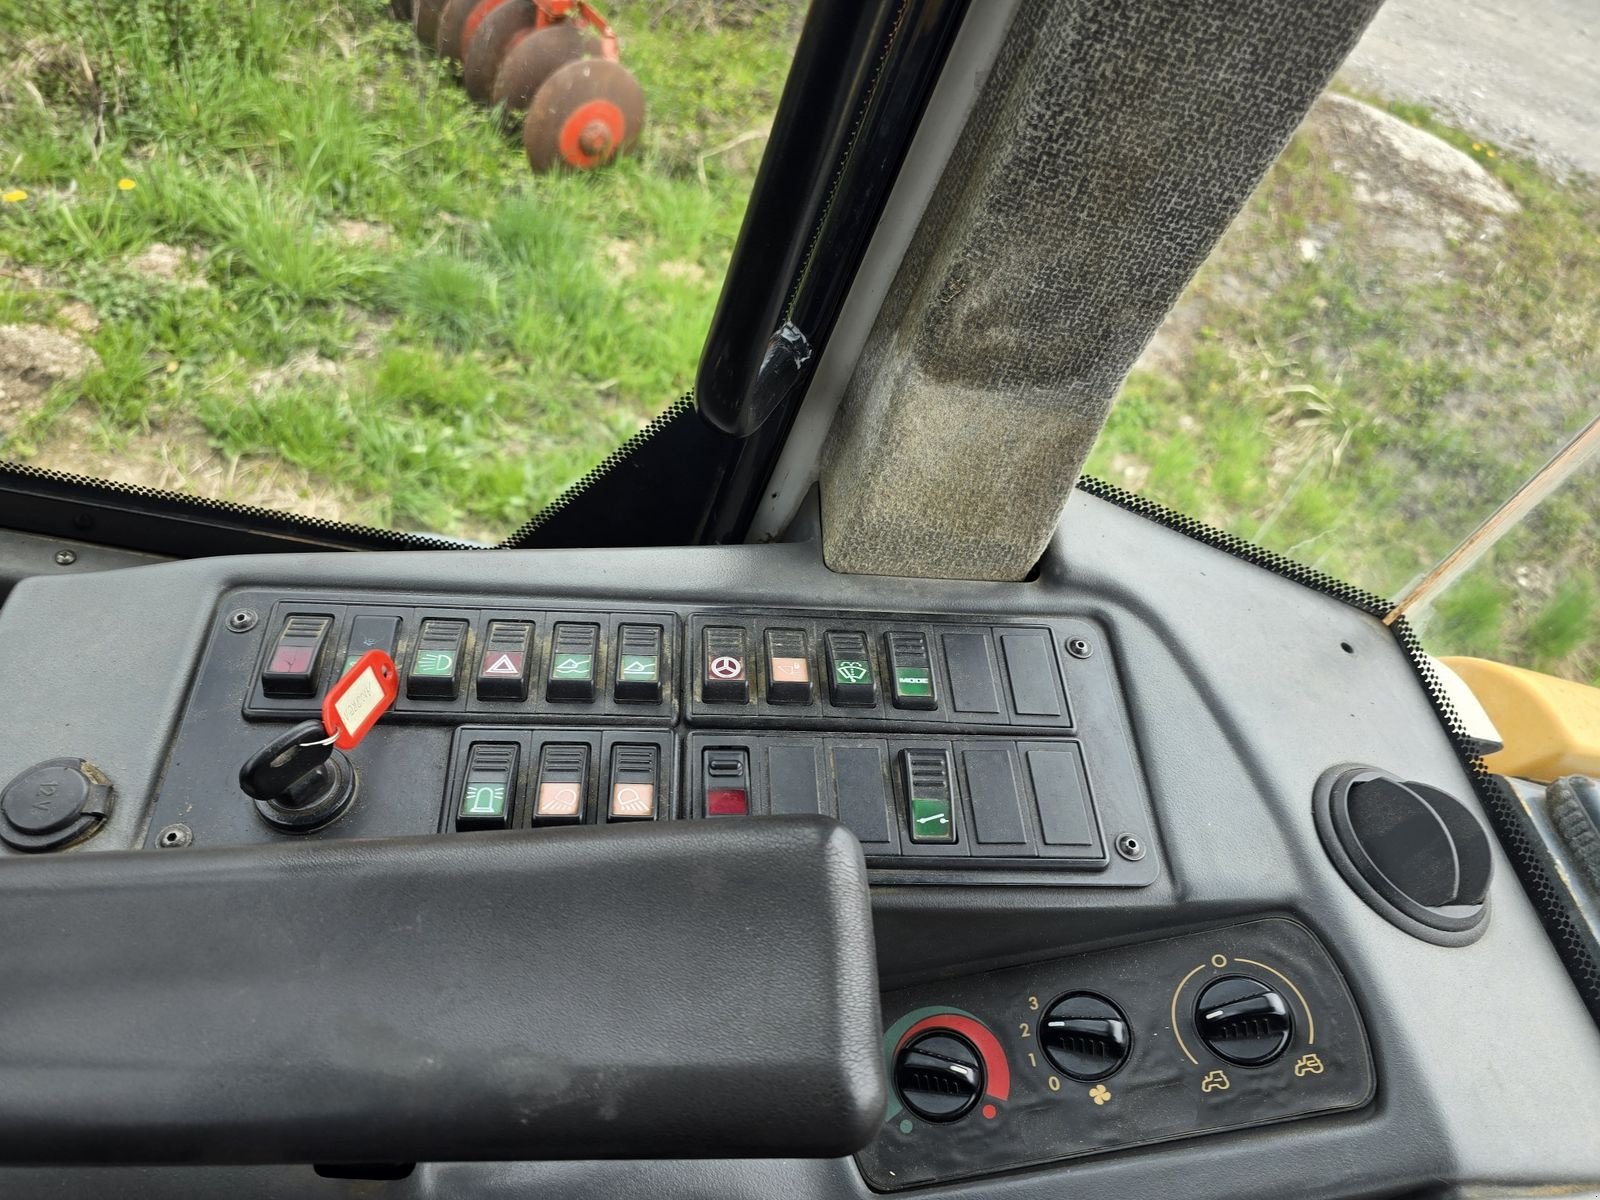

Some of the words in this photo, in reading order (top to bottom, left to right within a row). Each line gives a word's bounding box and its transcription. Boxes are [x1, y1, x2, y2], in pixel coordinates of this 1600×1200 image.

[1028, 996, 1039, 1010] 3
[1019, 1023, 1031, 1037] 2
[1028, 1053, 1036, 1067] 1
